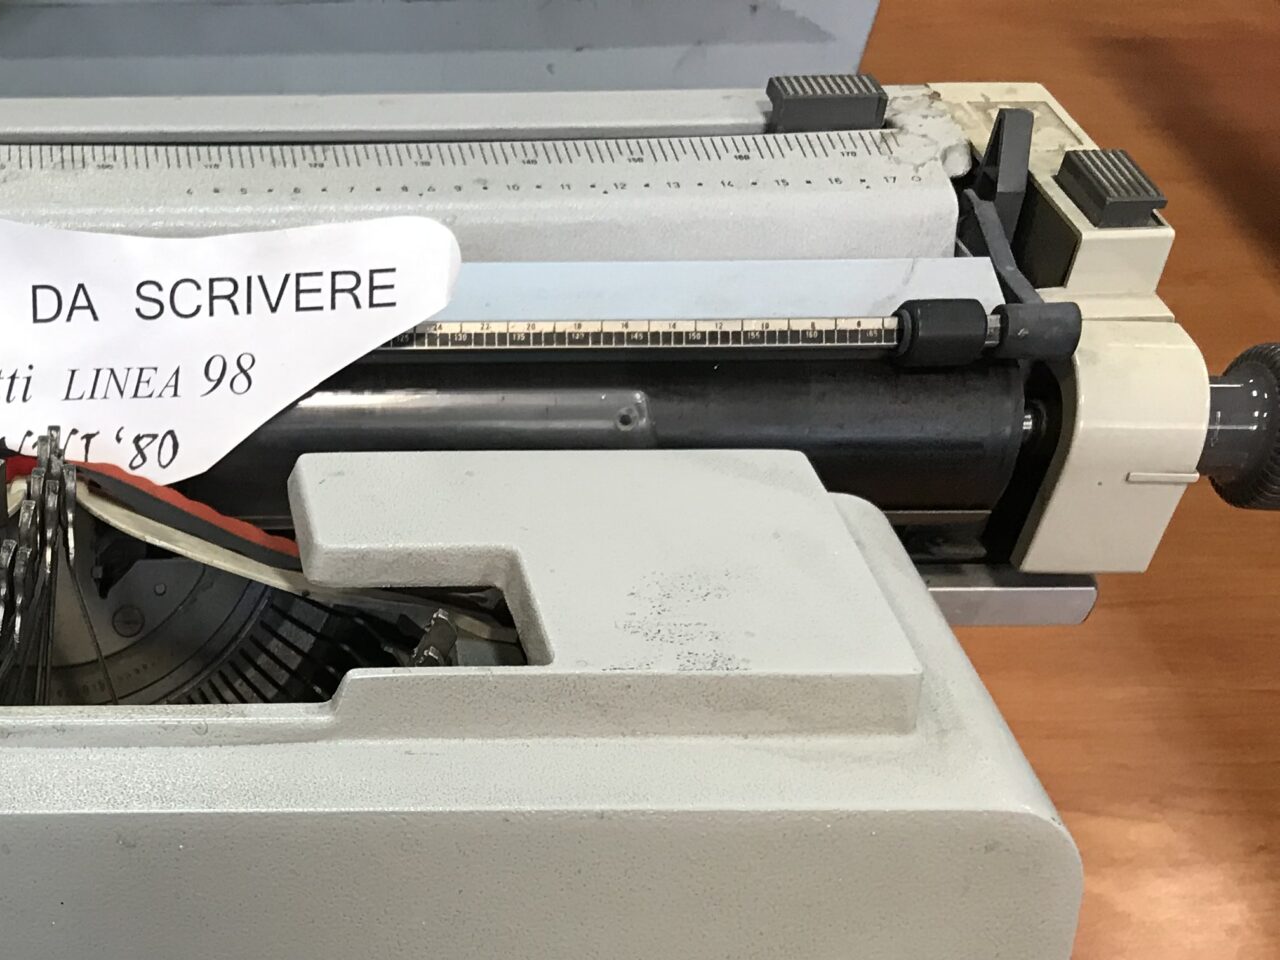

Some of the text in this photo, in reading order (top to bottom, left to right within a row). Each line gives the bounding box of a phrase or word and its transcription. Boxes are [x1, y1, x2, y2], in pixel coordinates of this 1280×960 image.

[31, 282, 100, 325] DA
[134, 267, 399, 322] SCRIVERE
[62, 364, 182, 402] LINEA
[202, 351, 257, 397] 98
